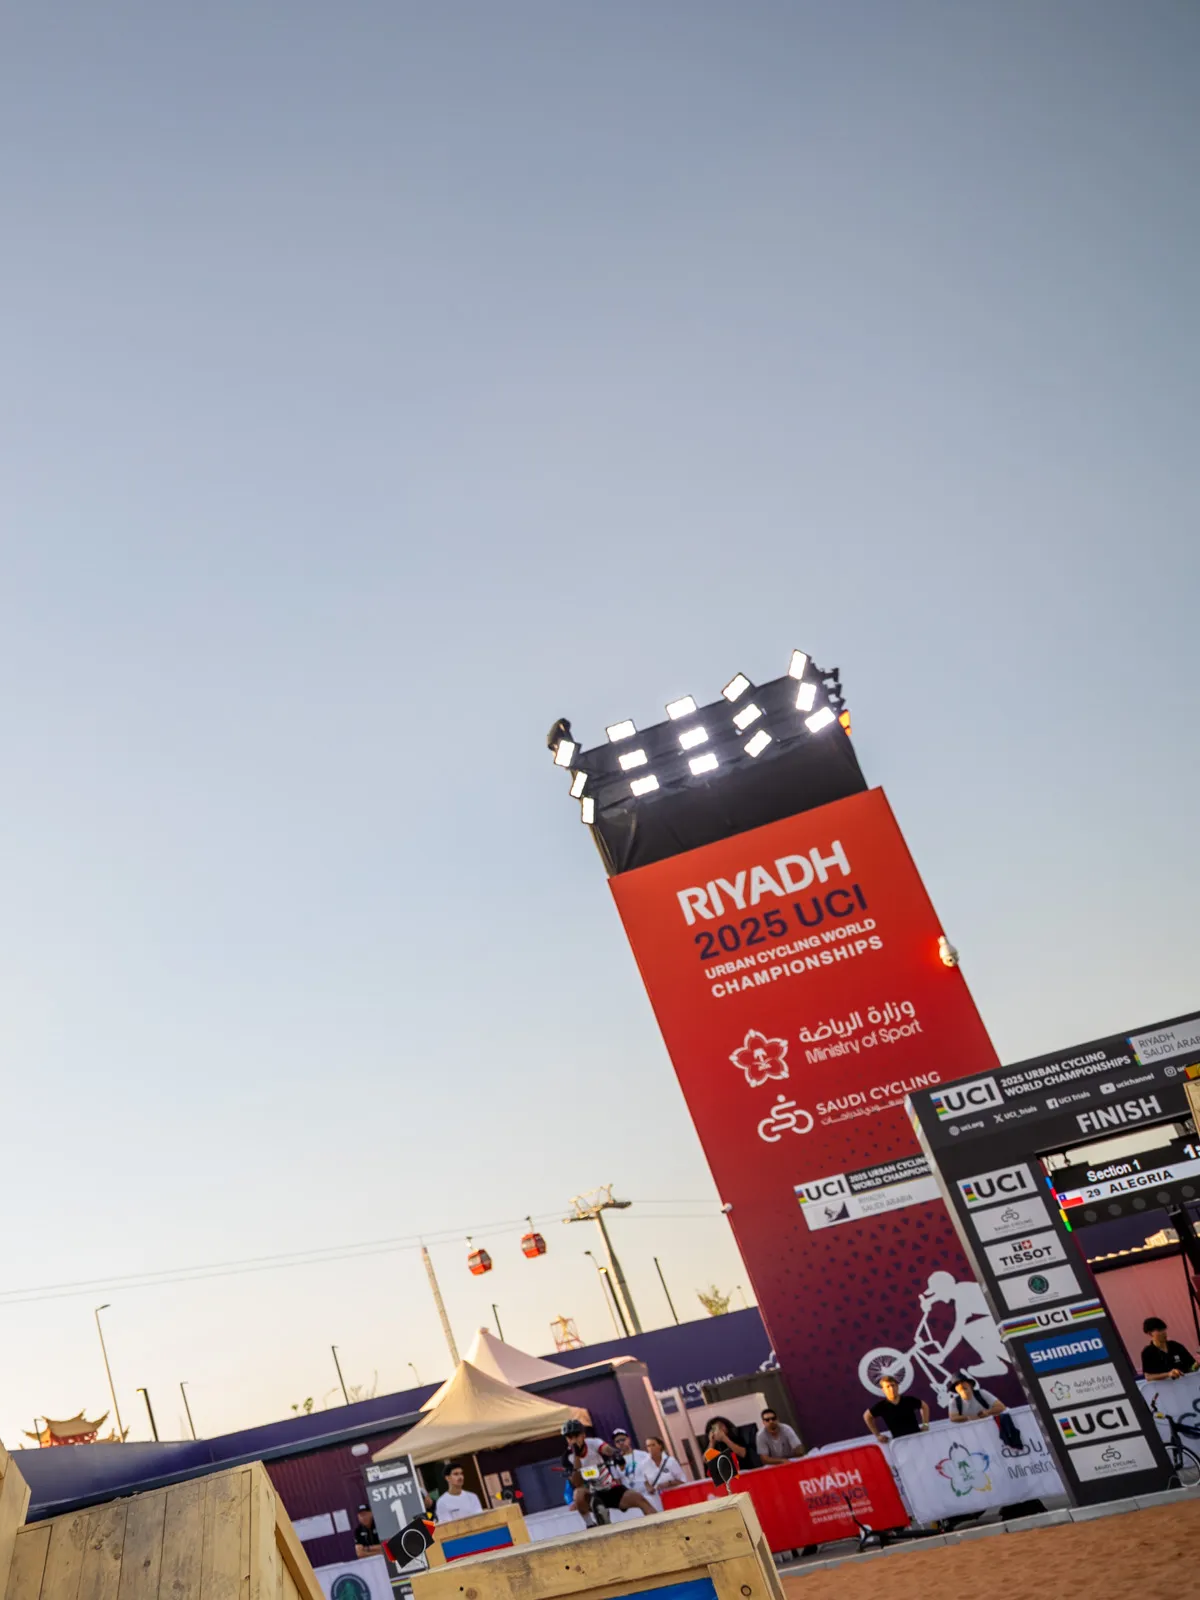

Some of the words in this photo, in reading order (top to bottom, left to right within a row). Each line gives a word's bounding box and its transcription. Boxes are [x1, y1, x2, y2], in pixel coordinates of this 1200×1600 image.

[676, 840, 851, 926] RIYADH
[694, 909, 788, 960] 2025
[793, 884, 868, 928] UCI
[705, 956, 757, 979] URBAN
[757, 935, 822, 963] CYCLING
[821, 919, 876, 943] WORLD
[711, 935, 884, 998] CHAMPIONSHIPS
[799, 1011, 864, 1042] الرياضة
[867, 1000, 916, 1025] وزارة
[805, 1039, 861, 1064] Ministry
[861, 1030, 879, 1048] of
[879, 1019, 923, 1044] Sport
[1138, 1031, 1176, 1049] RIYADH
[1143, 1044, 1175, 1060] SAUDI
[1001, 1074, 1024, 1088] 2025
[1024, 1064, 1061, 1081] URBAN
[1060, 1050, 1107, 1070] CYCLING
[1004, 1080, 1043, 1097] WORLD
[1044, 1055, 1131, 1087] CHAMPIONSHIPS
[816, 1092, 867, 1116] SAUDI
[869, 1071, 941, 1100] CYCLING
[943, 1083, 996, 1112] UCI
[1076, 1095, 1162, 1134] FINISH
[867, 1164, 896, 1179] URBAN
[896, 1156, 927, 1171] CYCLIN
[1086, 1163, 1132, 1182] Section
[1132, 1159, 1142, 1170] 1
[805, 1179, 846, 1201] UCI
[851, 1175, 883, 1191] WORLD
[973, 1170, 1028, 1198] UCI
[1086, 1188, 1102, 1199] 29
[1109, 1170, 1175, 1194] ALEGRIA
[999, 1246, 1052, 1266] TISSOT
[1036, 1310, 1069, 1326] UCI
[1030, 1338, 1103, 1363] SHIMANO
[1071, 1406, 1130, 1435] UCI
[372, 1480, 413, 1502] START
[798, 1468, 863, 1496] RIYADH
[390, 1498, 408, 1531] 1
